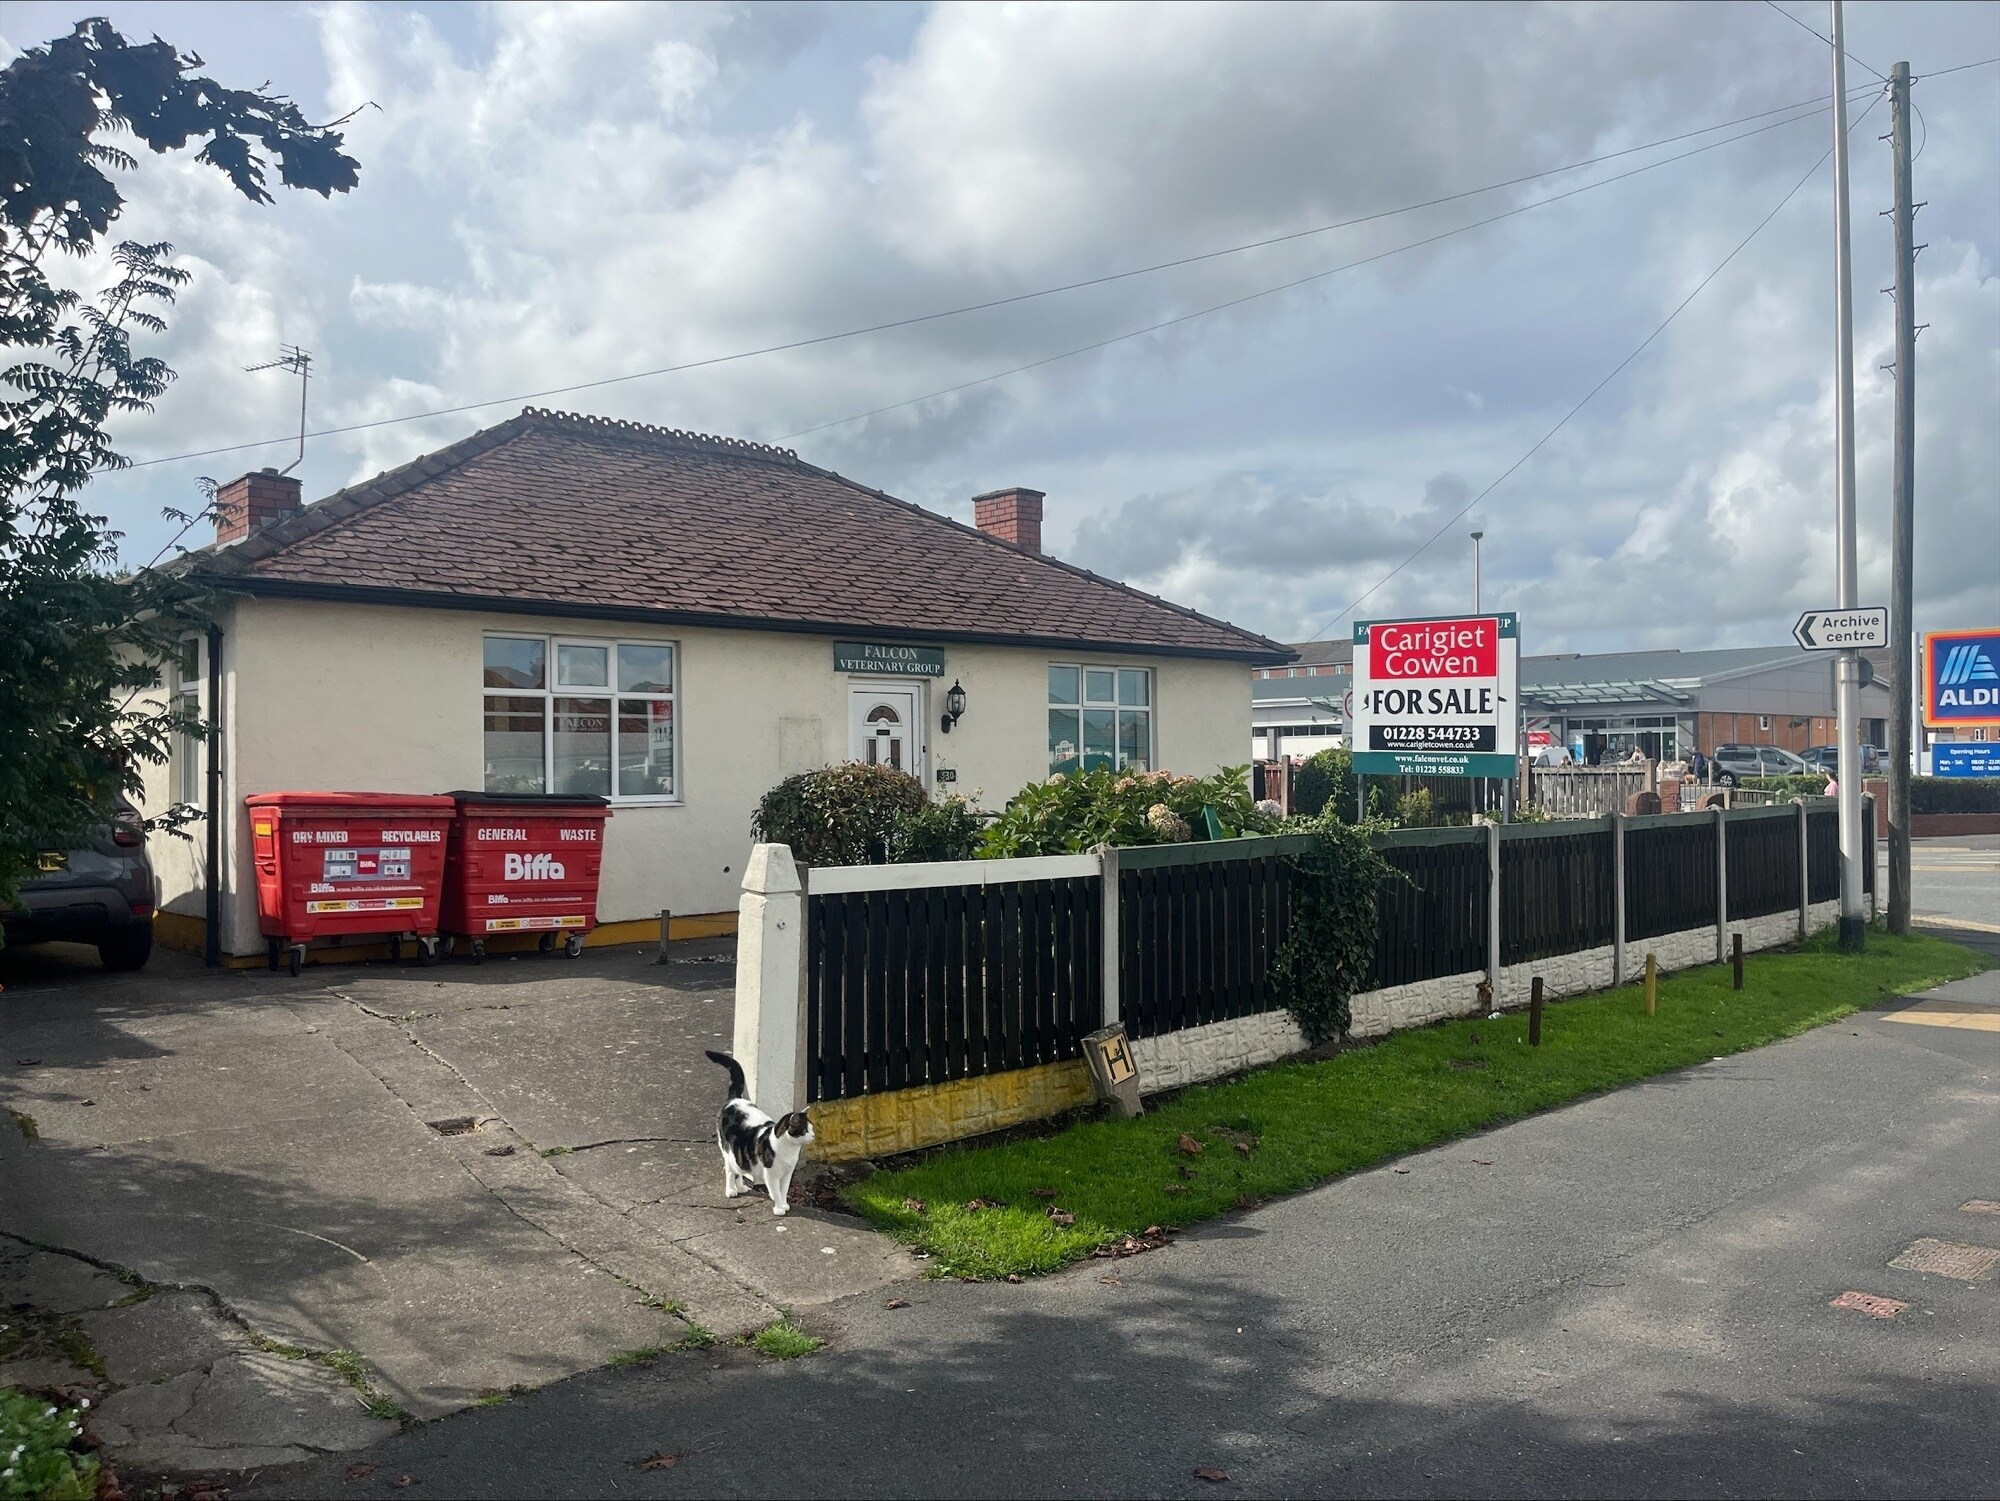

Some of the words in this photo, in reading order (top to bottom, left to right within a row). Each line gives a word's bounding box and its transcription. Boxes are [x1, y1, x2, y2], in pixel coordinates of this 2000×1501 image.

[1822, 615, 1879, 628] Archive
[1381, 626, 1484, 656] Carigiet
[1826, 630, 1875, 642] centre
[864, 644, 918, 660] FALCON
[840, 658, 905, 672] VETERINARY
[906, 662, 941, 674] GROUP
[1386, 653, 1477, 675] Cowen
[1373, 690, 1424, 714] FOR
[1428, 688, 1493, 714] SALE
[1939, 688, 1999, 707] ALDI
[1382, 726, 1425, 741] 01228
[1427, 726, 1481, 741] 544733
[1386, 740, 1475, 750] www.carigietcowen.co.uk
[1394, 754, 1470, 764] www.falconvet.co.uk
[1399, 764, 1414, 773] Tel:
[1415, 764, 1438, 774] 01228
[1438, 765, 1465, 774] 558833
[293, 831, 314, 844] DRY
[316, 830, 349, 843] MIXED
[381, 830, 441, 843] RECYCLABLES
[478, 828, 528, 841] GENERAL
[560, 829, 597, 841] WASTE
[359, 860, 377, 868] Biffa
[504, 852, 565, 881] Biffa
[310, 883, 336, 893] Biffa
[488, 894, 509, 904] Biffa
[1103, 1038, 1131, 1080] H
